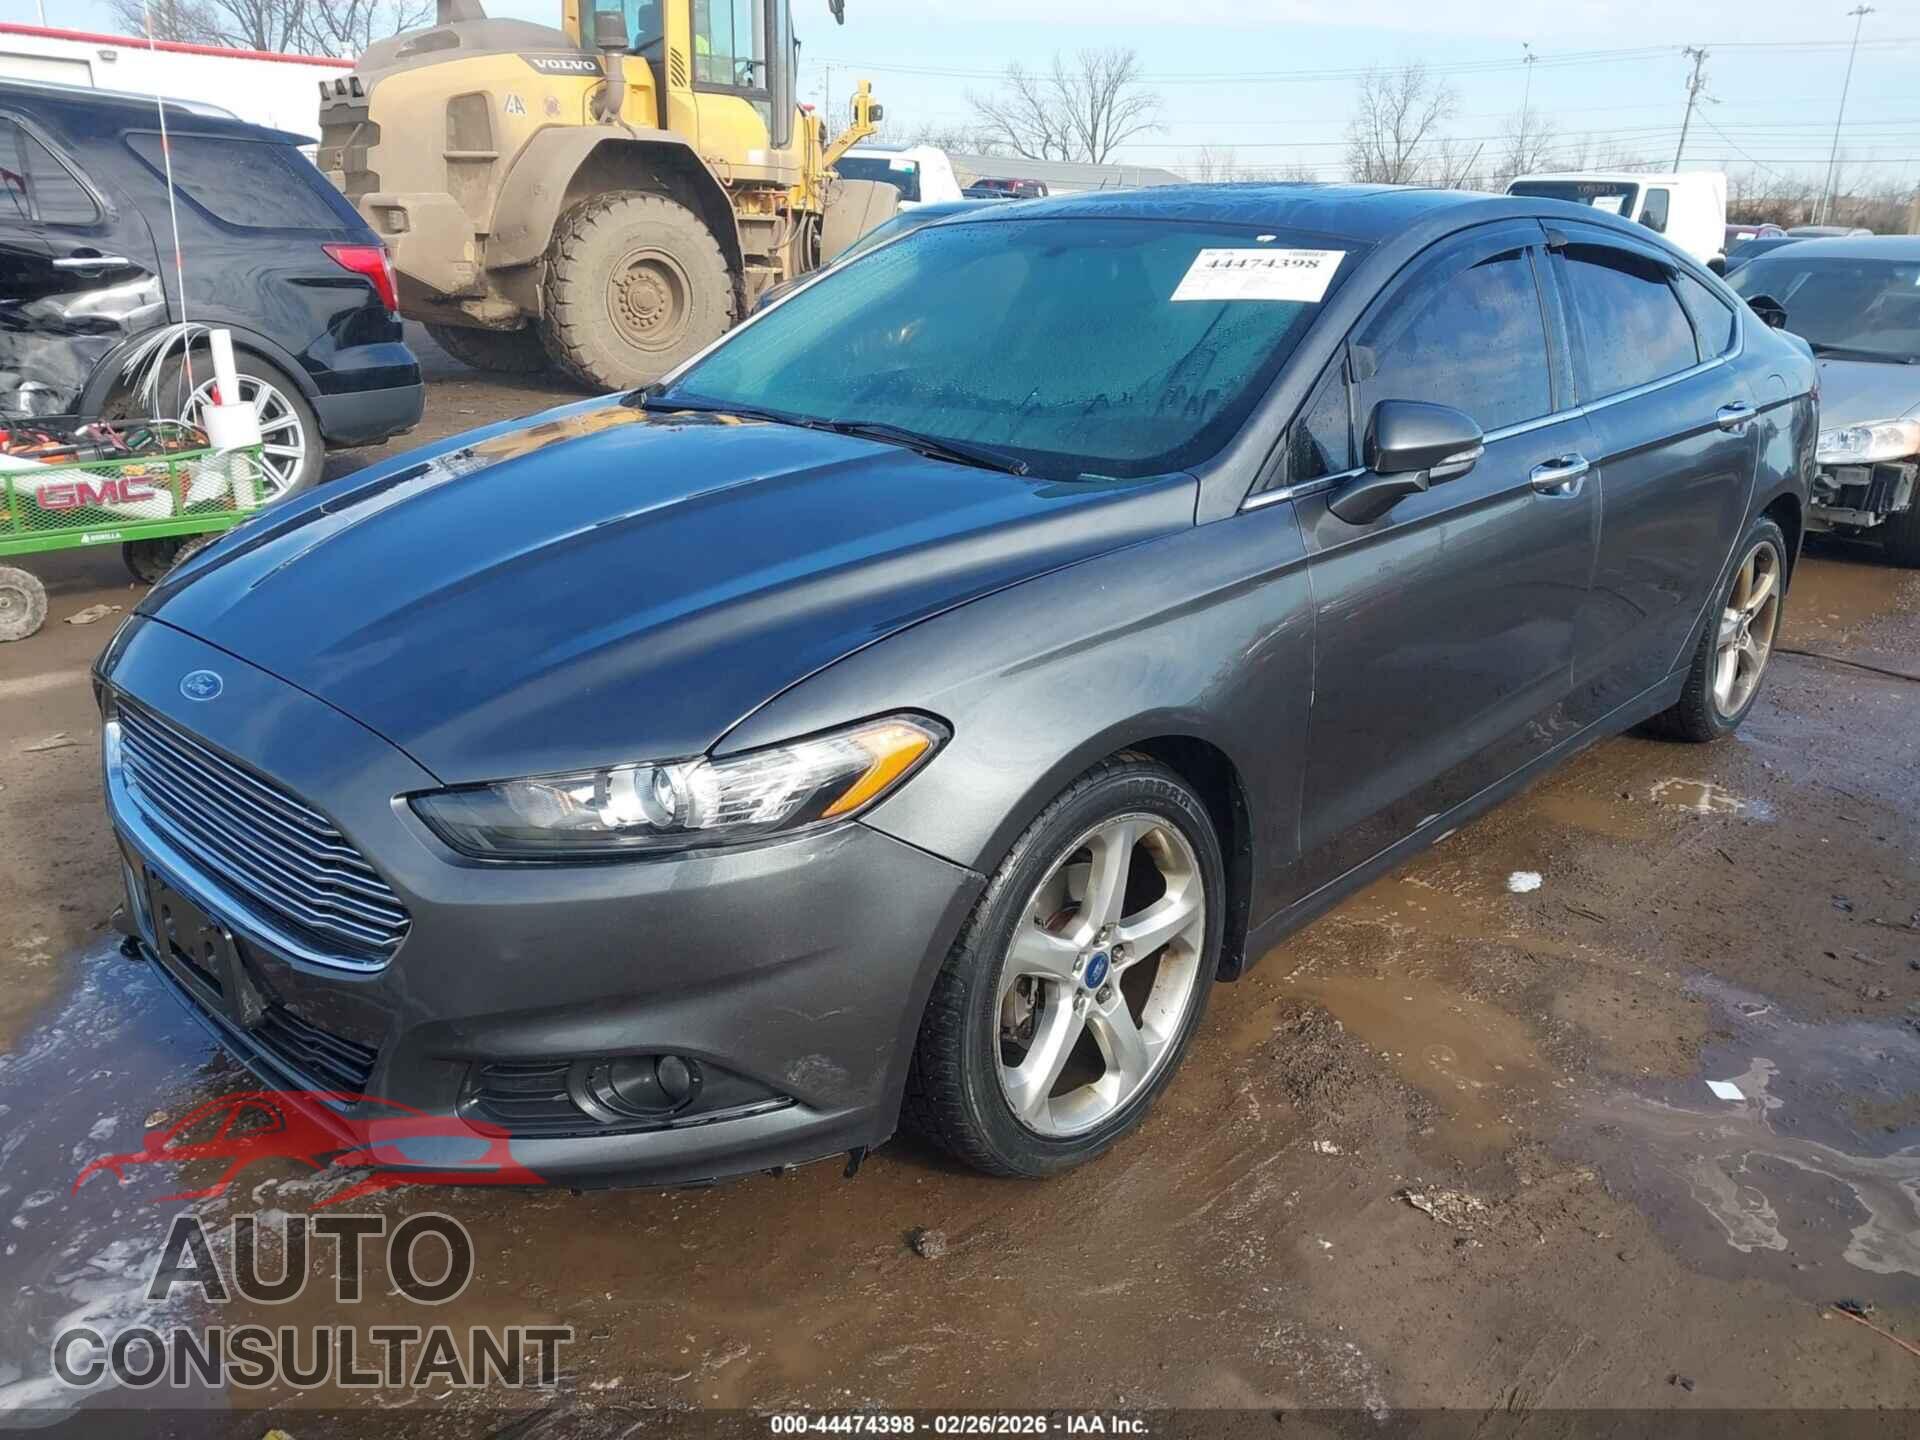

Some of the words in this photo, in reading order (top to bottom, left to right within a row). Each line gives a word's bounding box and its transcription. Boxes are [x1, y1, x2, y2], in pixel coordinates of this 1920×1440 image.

[534, 59, 596, 71] VOLVO
[1205, 258, 1320, 269] 44474398
[36, 476, 155, 510] GMC
